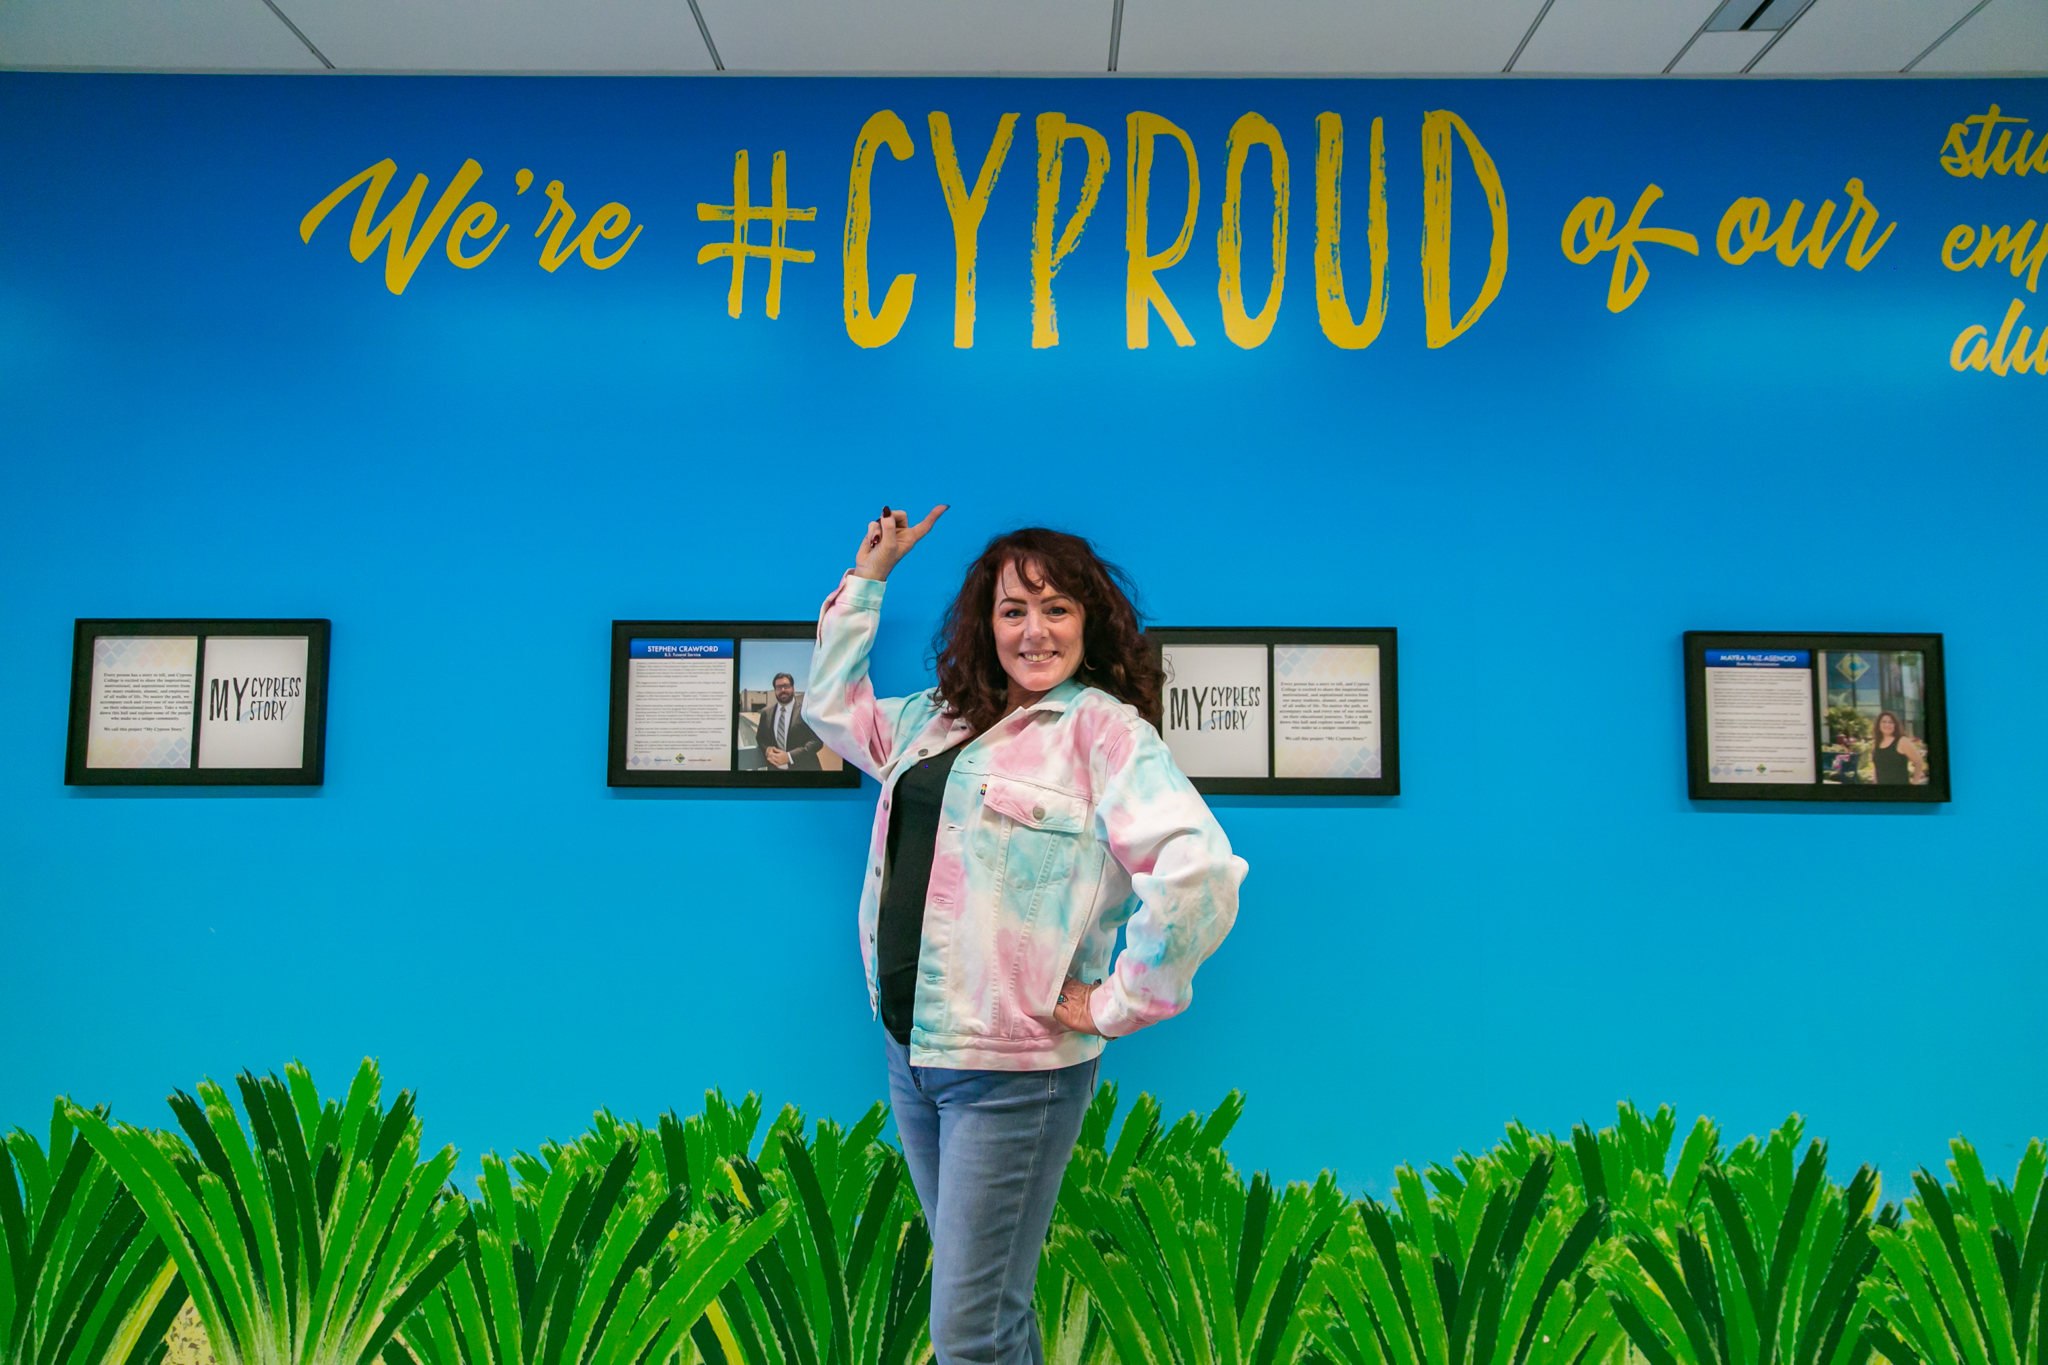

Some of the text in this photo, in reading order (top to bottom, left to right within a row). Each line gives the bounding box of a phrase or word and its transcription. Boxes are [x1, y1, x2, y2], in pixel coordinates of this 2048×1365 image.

[1941, 104, 2048, 178] stu
[300, 110, 1896, 349] We're #CYPROUD of our
[209, 677, 301, 721] MY CYPRESS
[250, 701, 287, 720] STORY
[1170, 686, 1260, 730] MY CYPRESS
[1211, 710, 1247, 730] STORY
